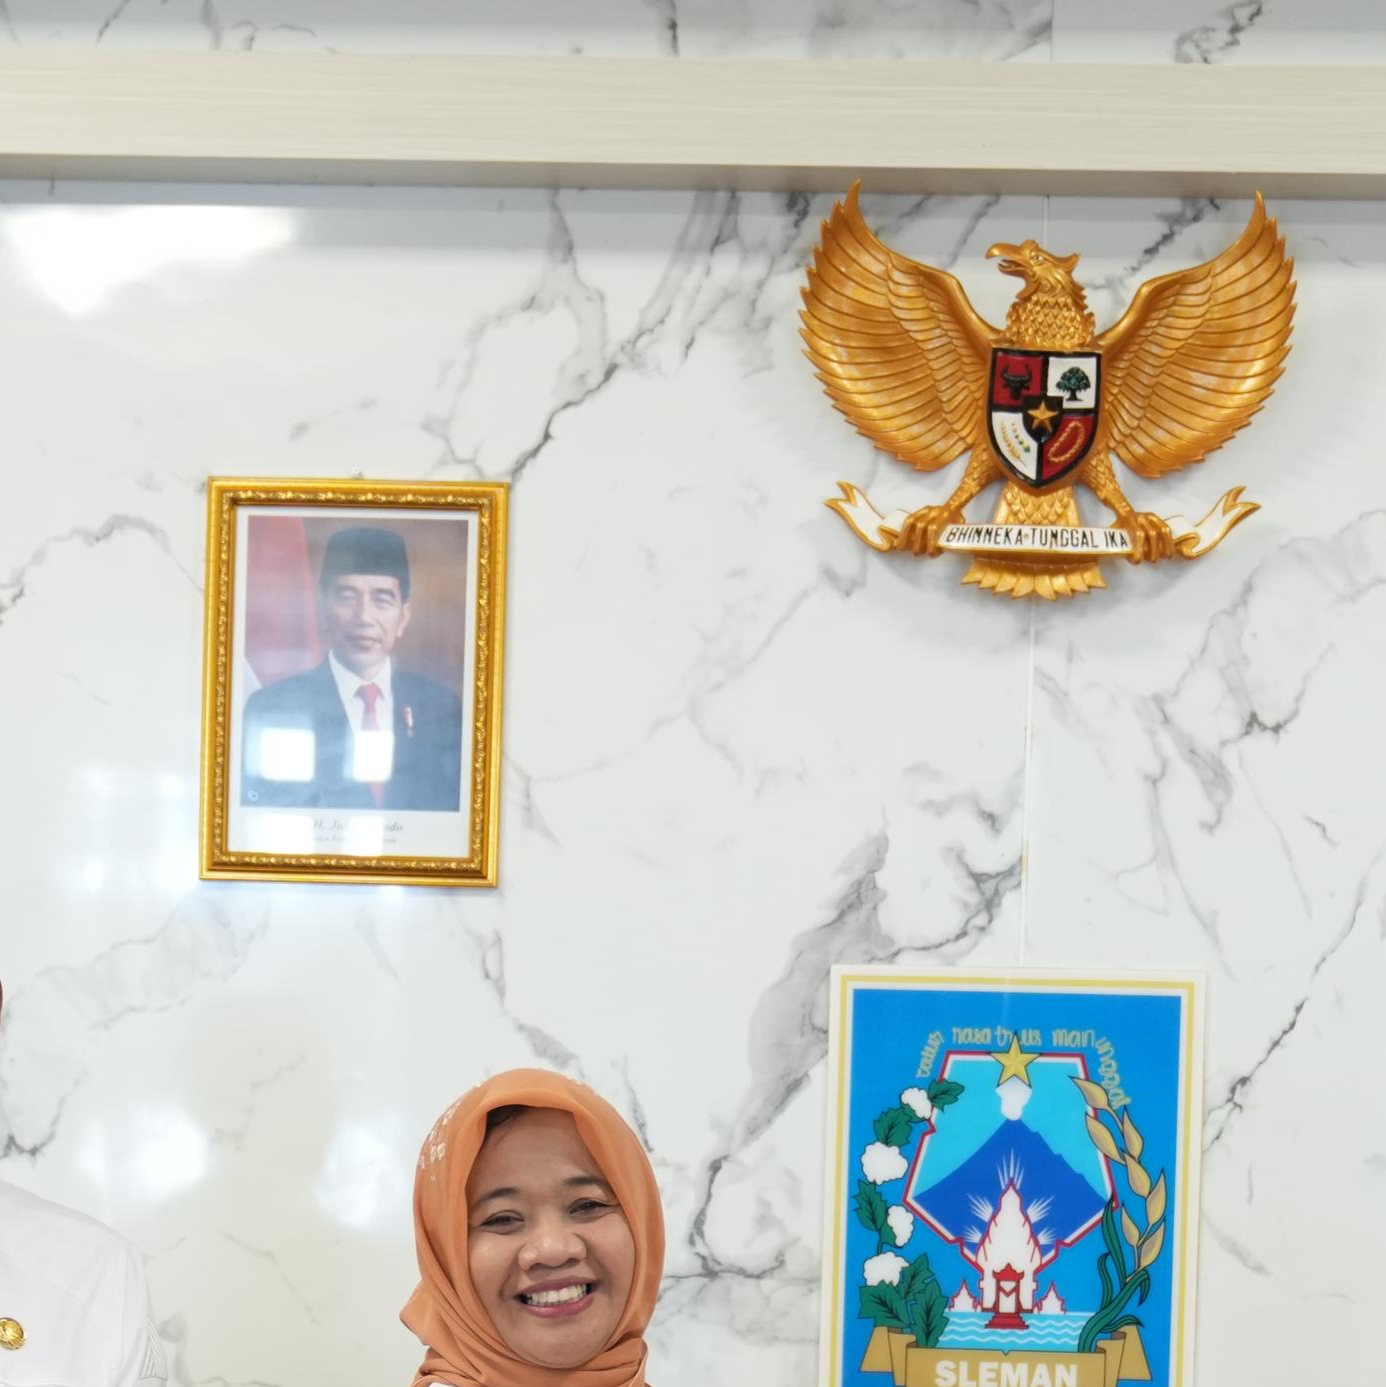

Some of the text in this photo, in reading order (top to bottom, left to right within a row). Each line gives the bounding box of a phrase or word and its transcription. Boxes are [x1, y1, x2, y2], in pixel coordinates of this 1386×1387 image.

[945, 527, 1129, 549] BHINNEKA TUNGGAL IKA
